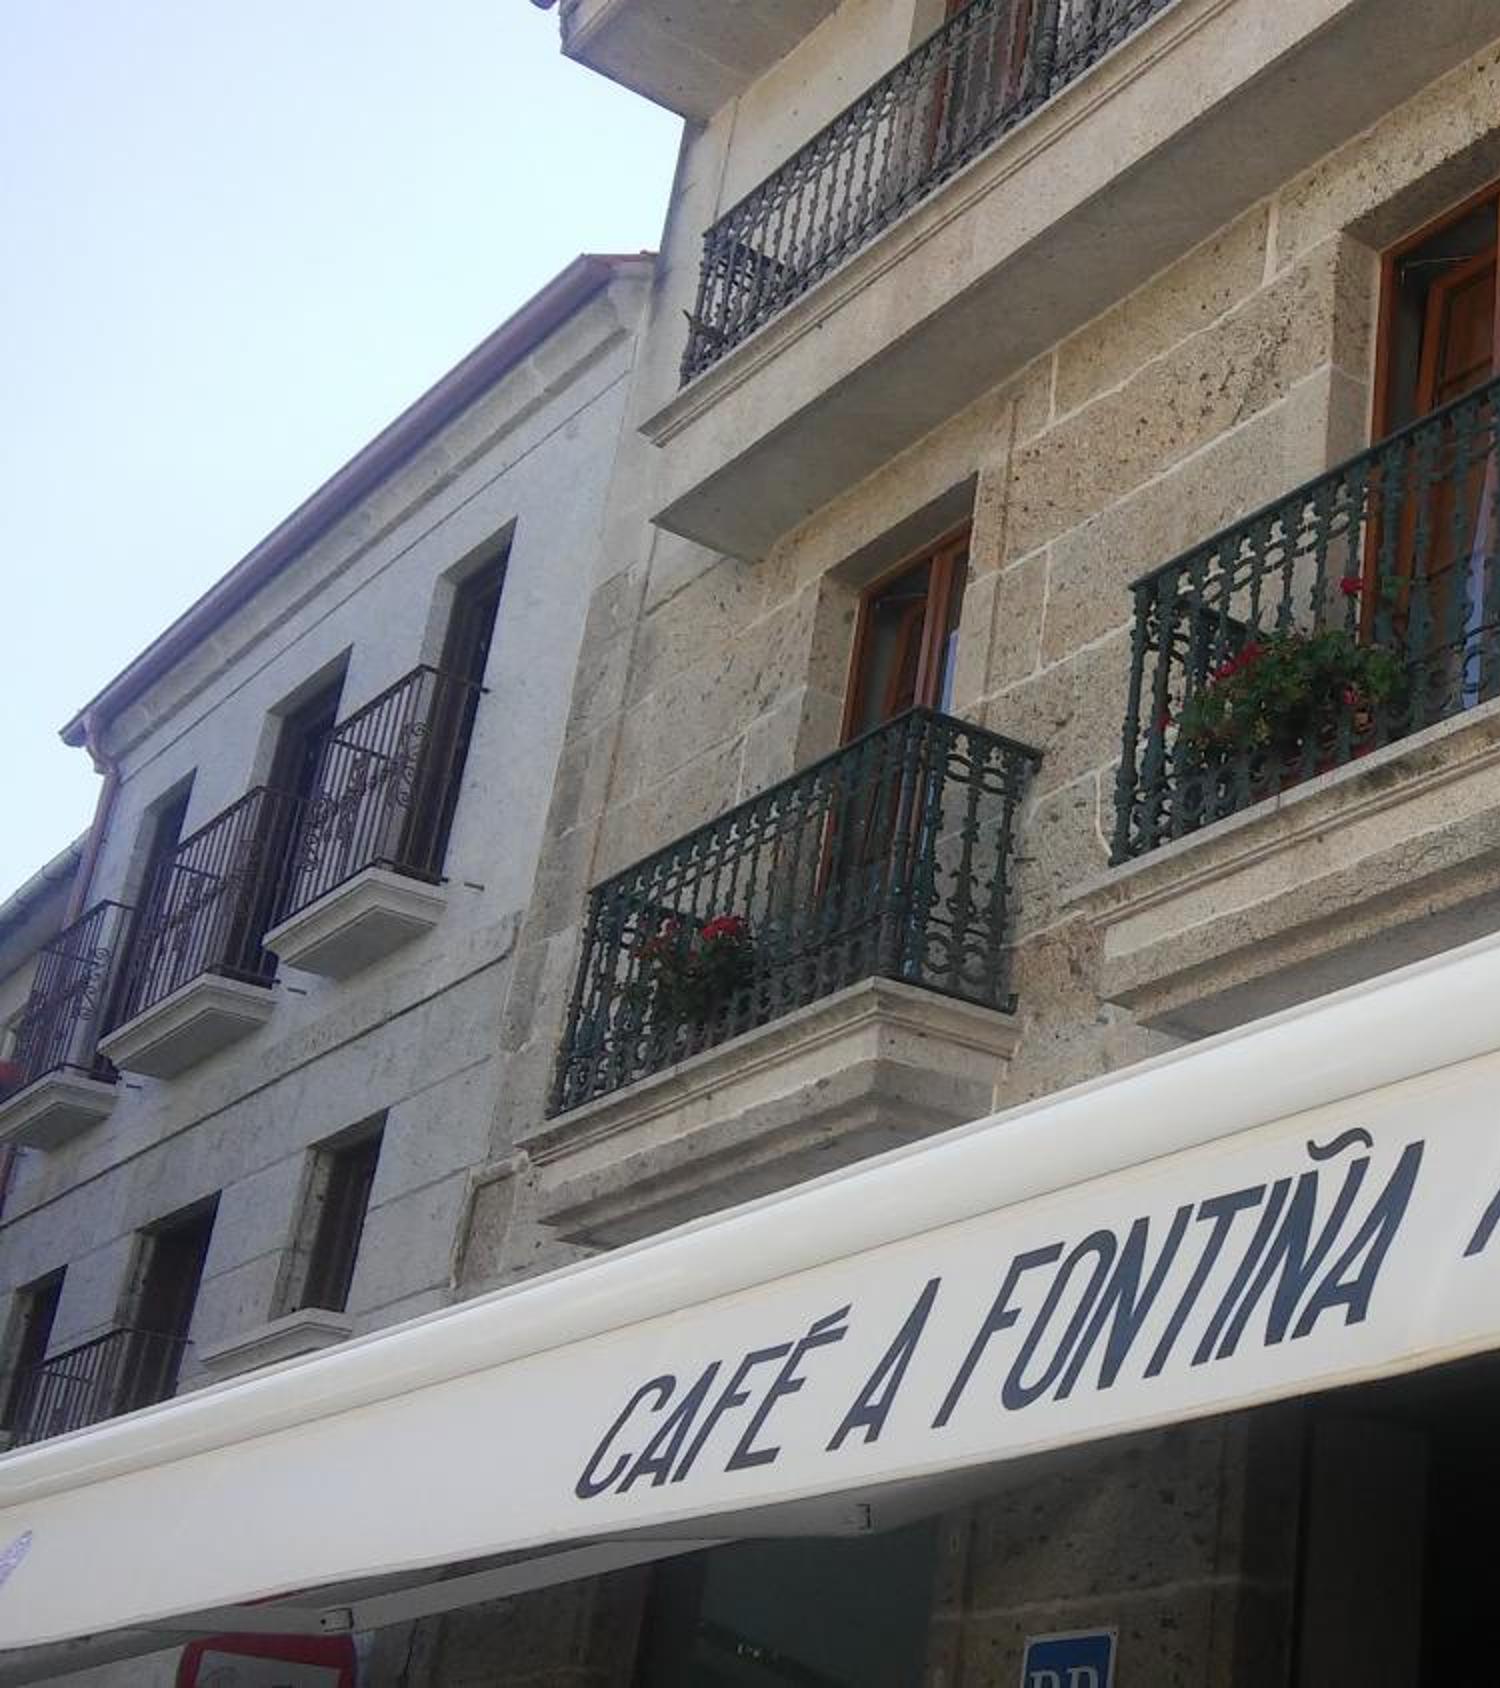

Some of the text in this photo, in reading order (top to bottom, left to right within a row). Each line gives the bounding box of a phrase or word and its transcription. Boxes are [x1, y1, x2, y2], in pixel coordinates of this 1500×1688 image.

[575, 1304, 852, 1499] CAFÉ
[826, 1277, 942, 1451] A
[931, 1127, 1426, 1429] FONTIÑA
